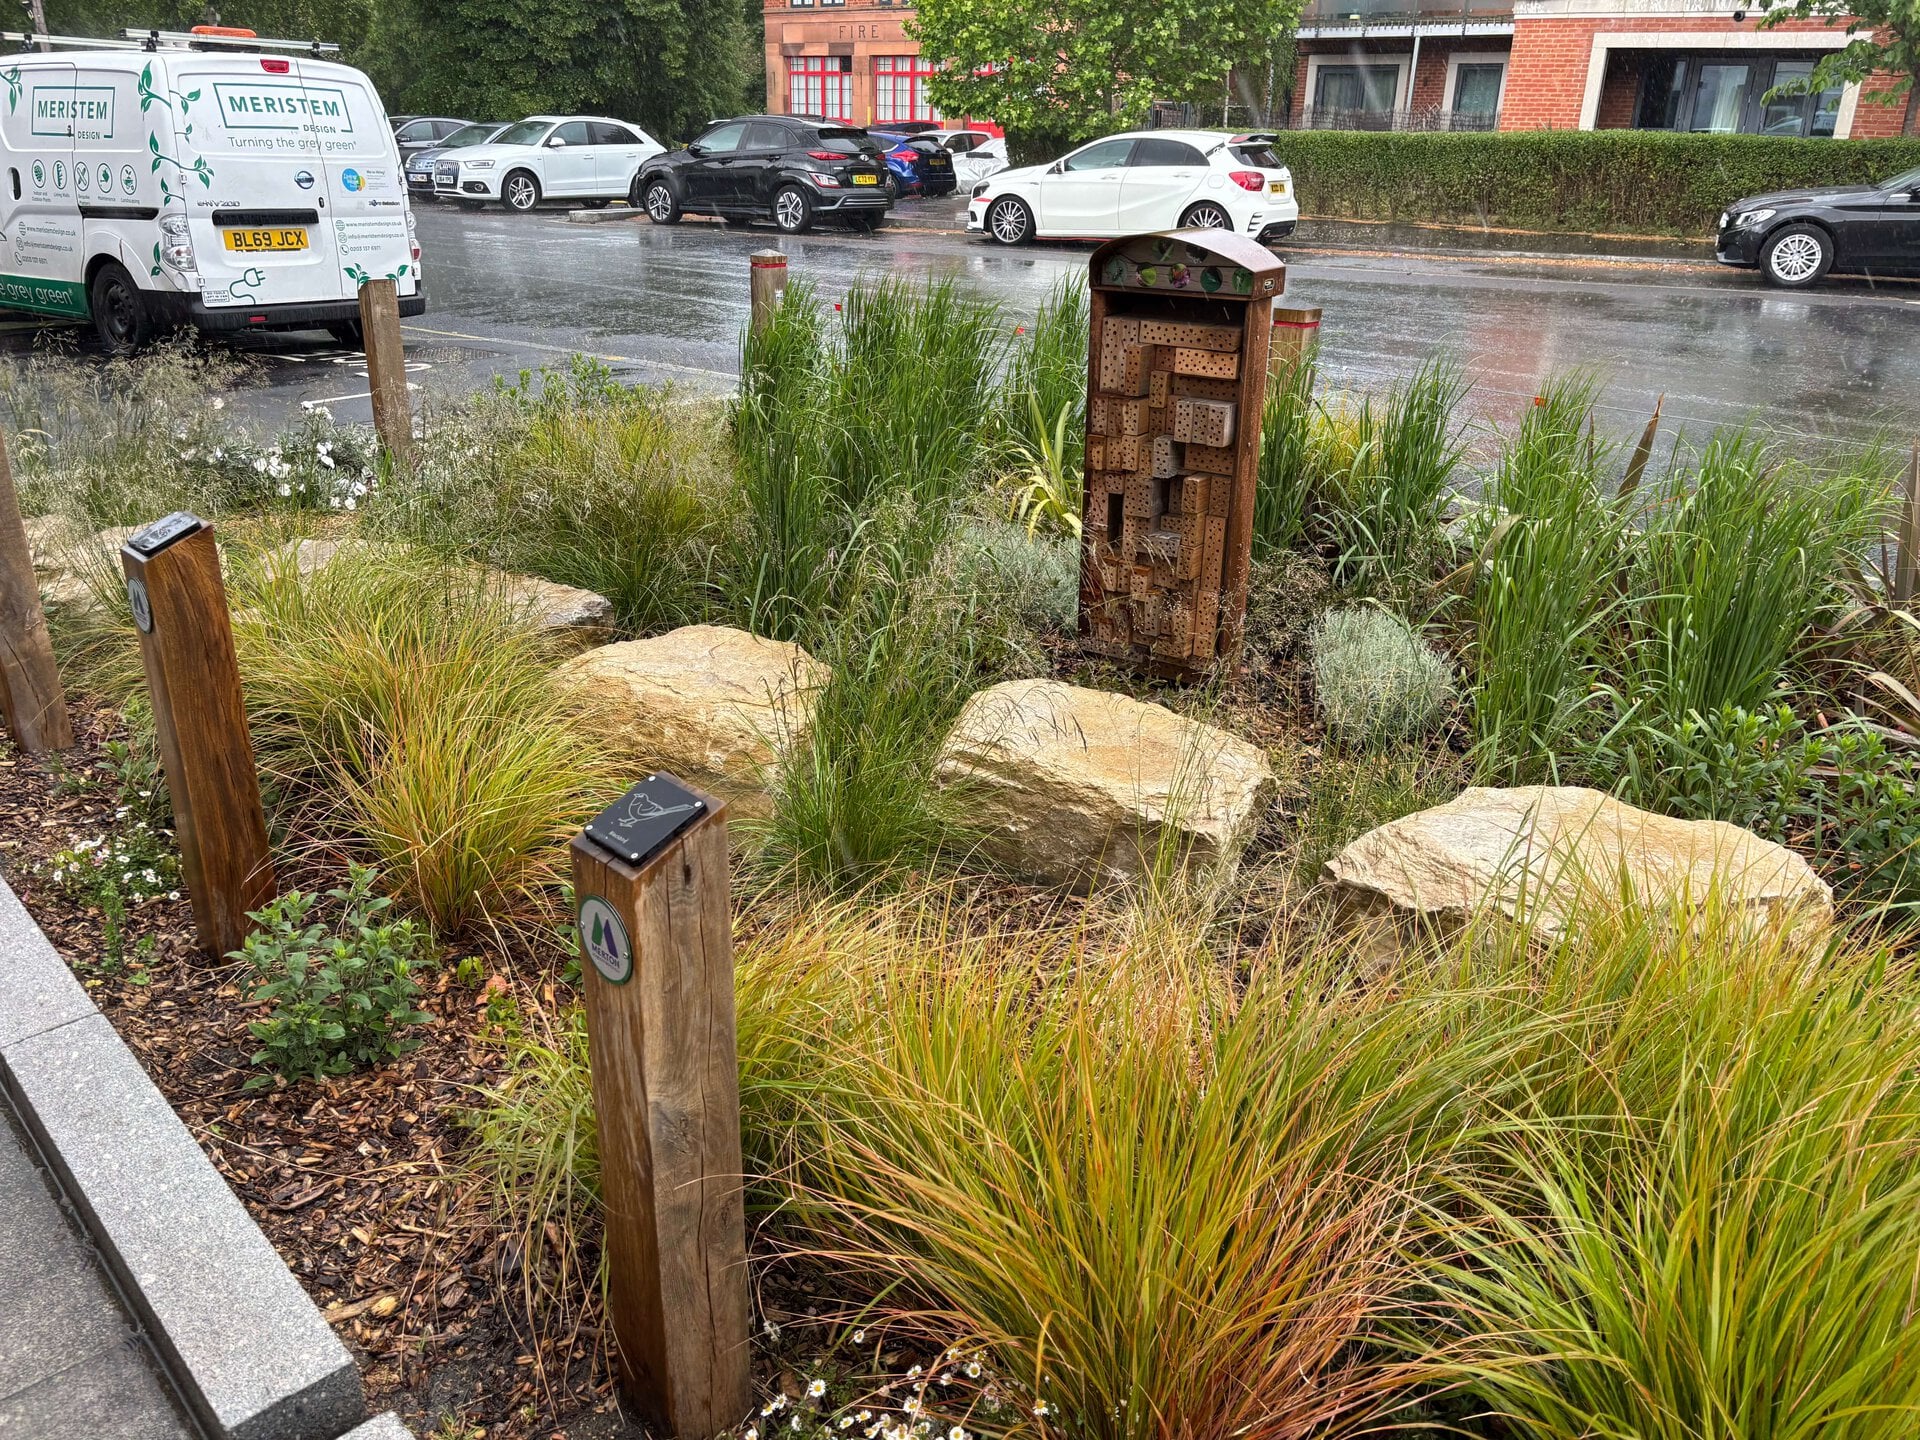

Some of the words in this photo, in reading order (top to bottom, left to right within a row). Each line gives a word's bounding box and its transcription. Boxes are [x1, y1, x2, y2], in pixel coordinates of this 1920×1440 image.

[839, 25, 879, 39] FIRE
[38, 100, 107, 119] MERISTEM
[228, 96, 340, 116] MERISTEM
[77, 131, 101, 139] DESIGN
[303, 124, 336, 133] DESIGN
[227, 136, 273, 149] Turning
[276, 137, 295, 148] the
[297, 139, 322, 150] grey
[232, 232, 272, 247] BL69
[277, 231, 304, 246] JCX
[6, 283, 34, 302] grey
[592, 943, 620, 969] MERTON
